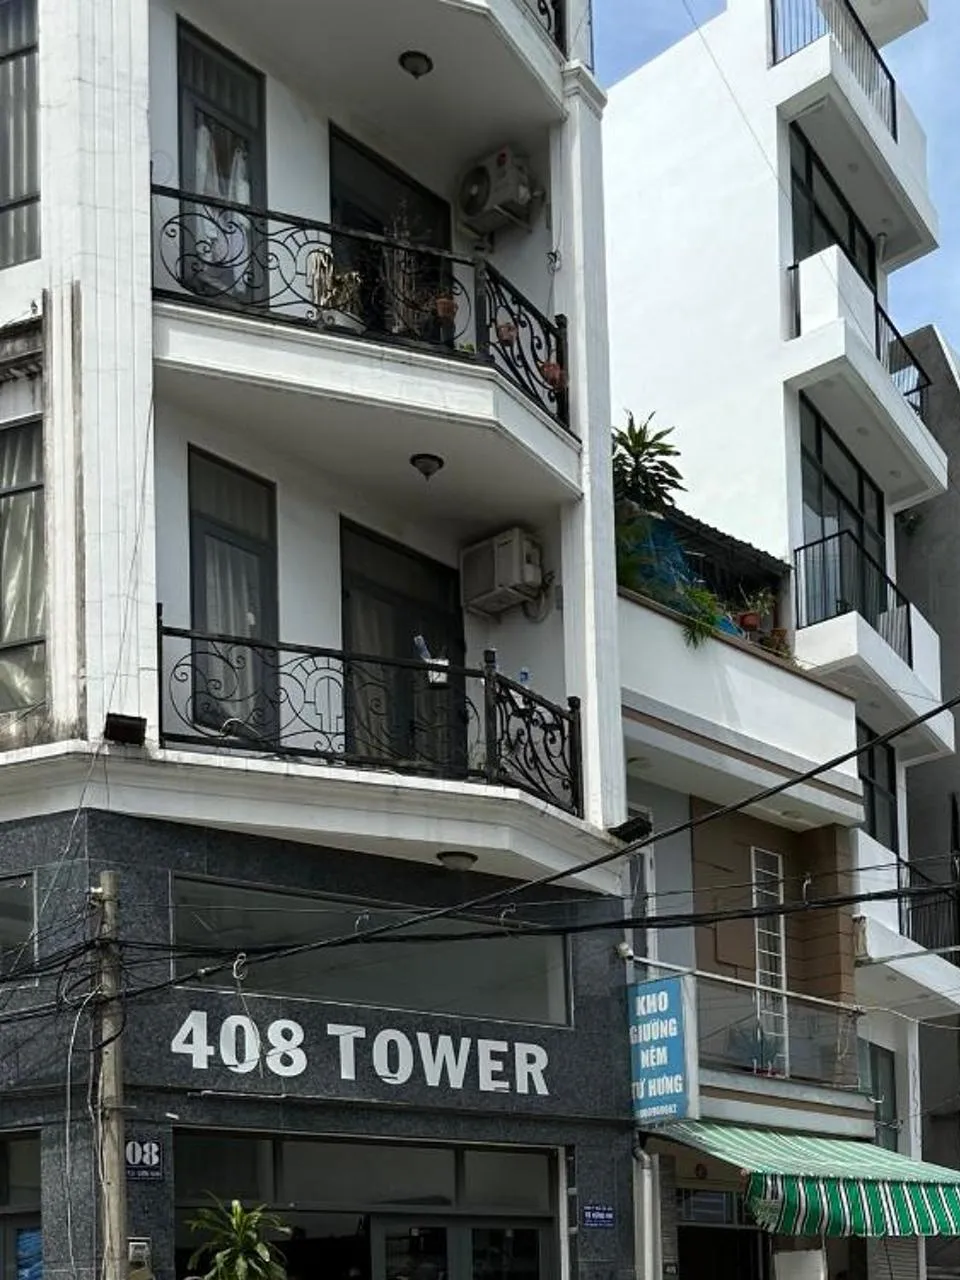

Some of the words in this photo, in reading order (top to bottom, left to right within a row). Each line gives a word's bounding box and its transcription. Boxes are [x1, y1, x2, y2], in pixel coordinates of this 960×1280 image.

[636, 990, 669, 1016] KHO
[170, 1010, 307, 1077] 408
[327, 1023, 551, 1096] TOWER
[126, 1141, 160, 1166] 08
